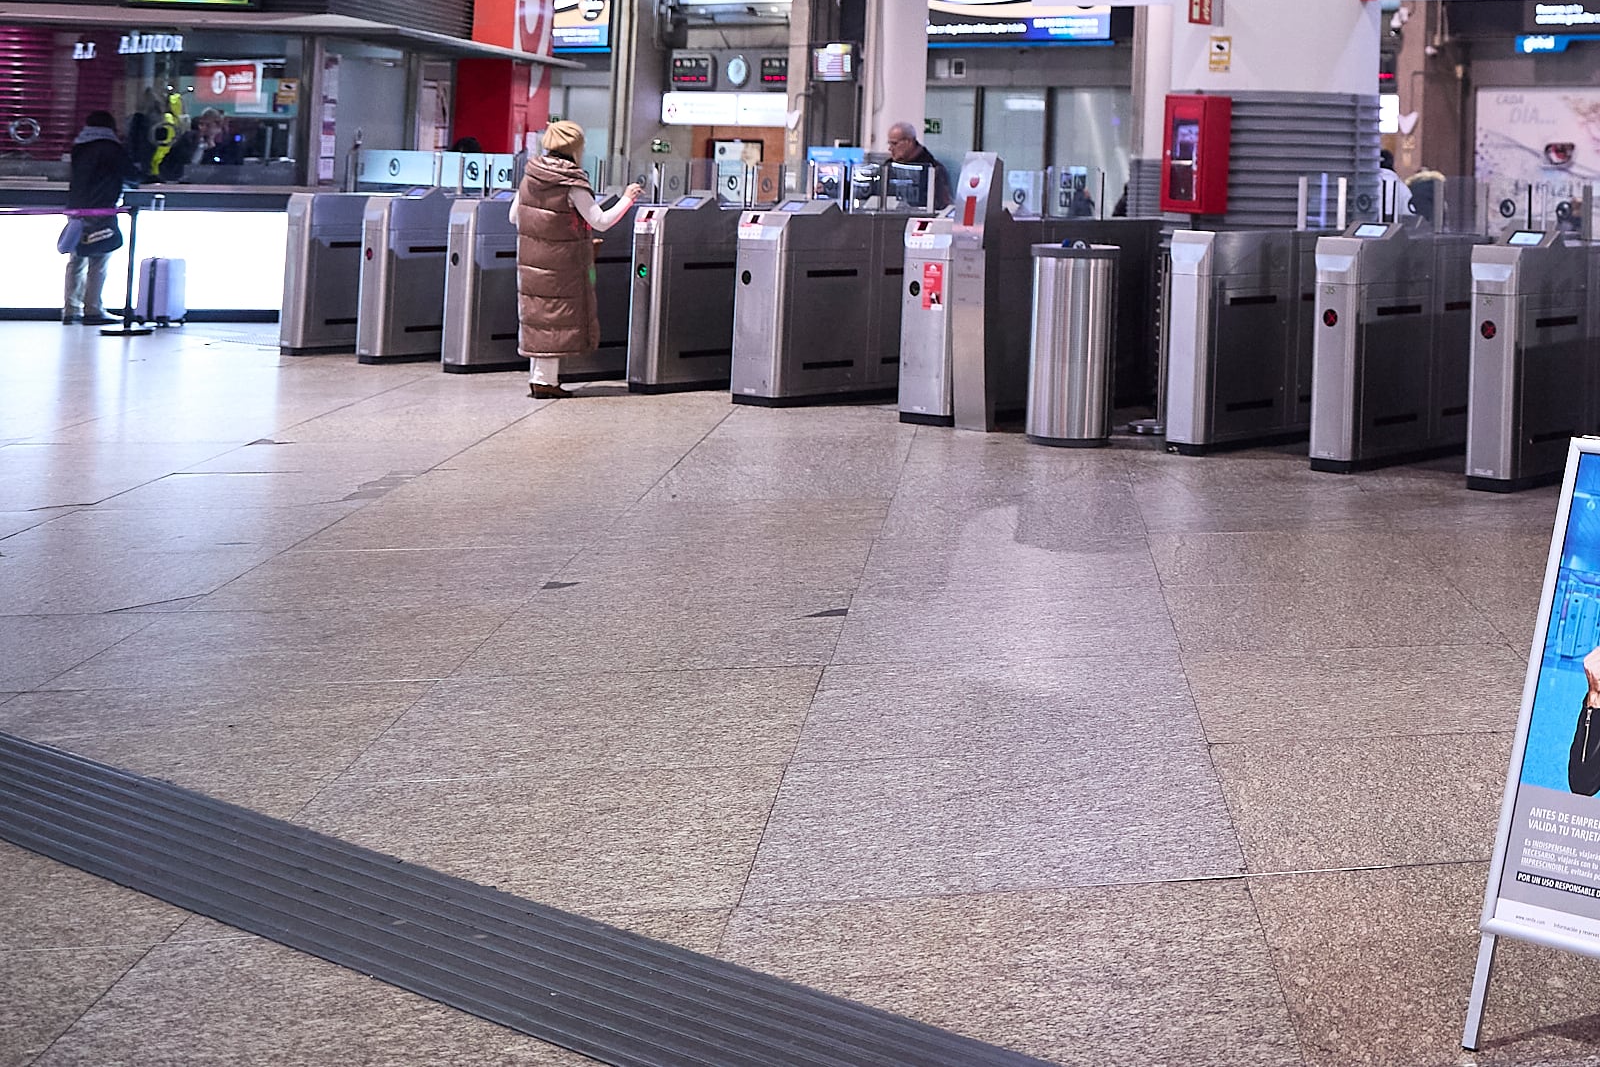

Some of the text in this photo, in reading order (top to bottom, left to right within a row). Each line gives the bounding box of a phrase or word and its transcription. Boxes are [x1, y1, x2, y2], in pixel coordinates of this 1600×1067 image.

[1530, 807, 1556, 821] ANTES
[1558, 812, 1570, 823] DE
[1528, 818, 1557, 834] VALIDA
[1559, 825, 1570, 836] TU
[1517, 872, 1530, 882] POR
[1531, 875, 1541, 884] UN
[1541, 878, 1554, 888] USO
[1555, 880, 1595, 898] RESPONSABLE
